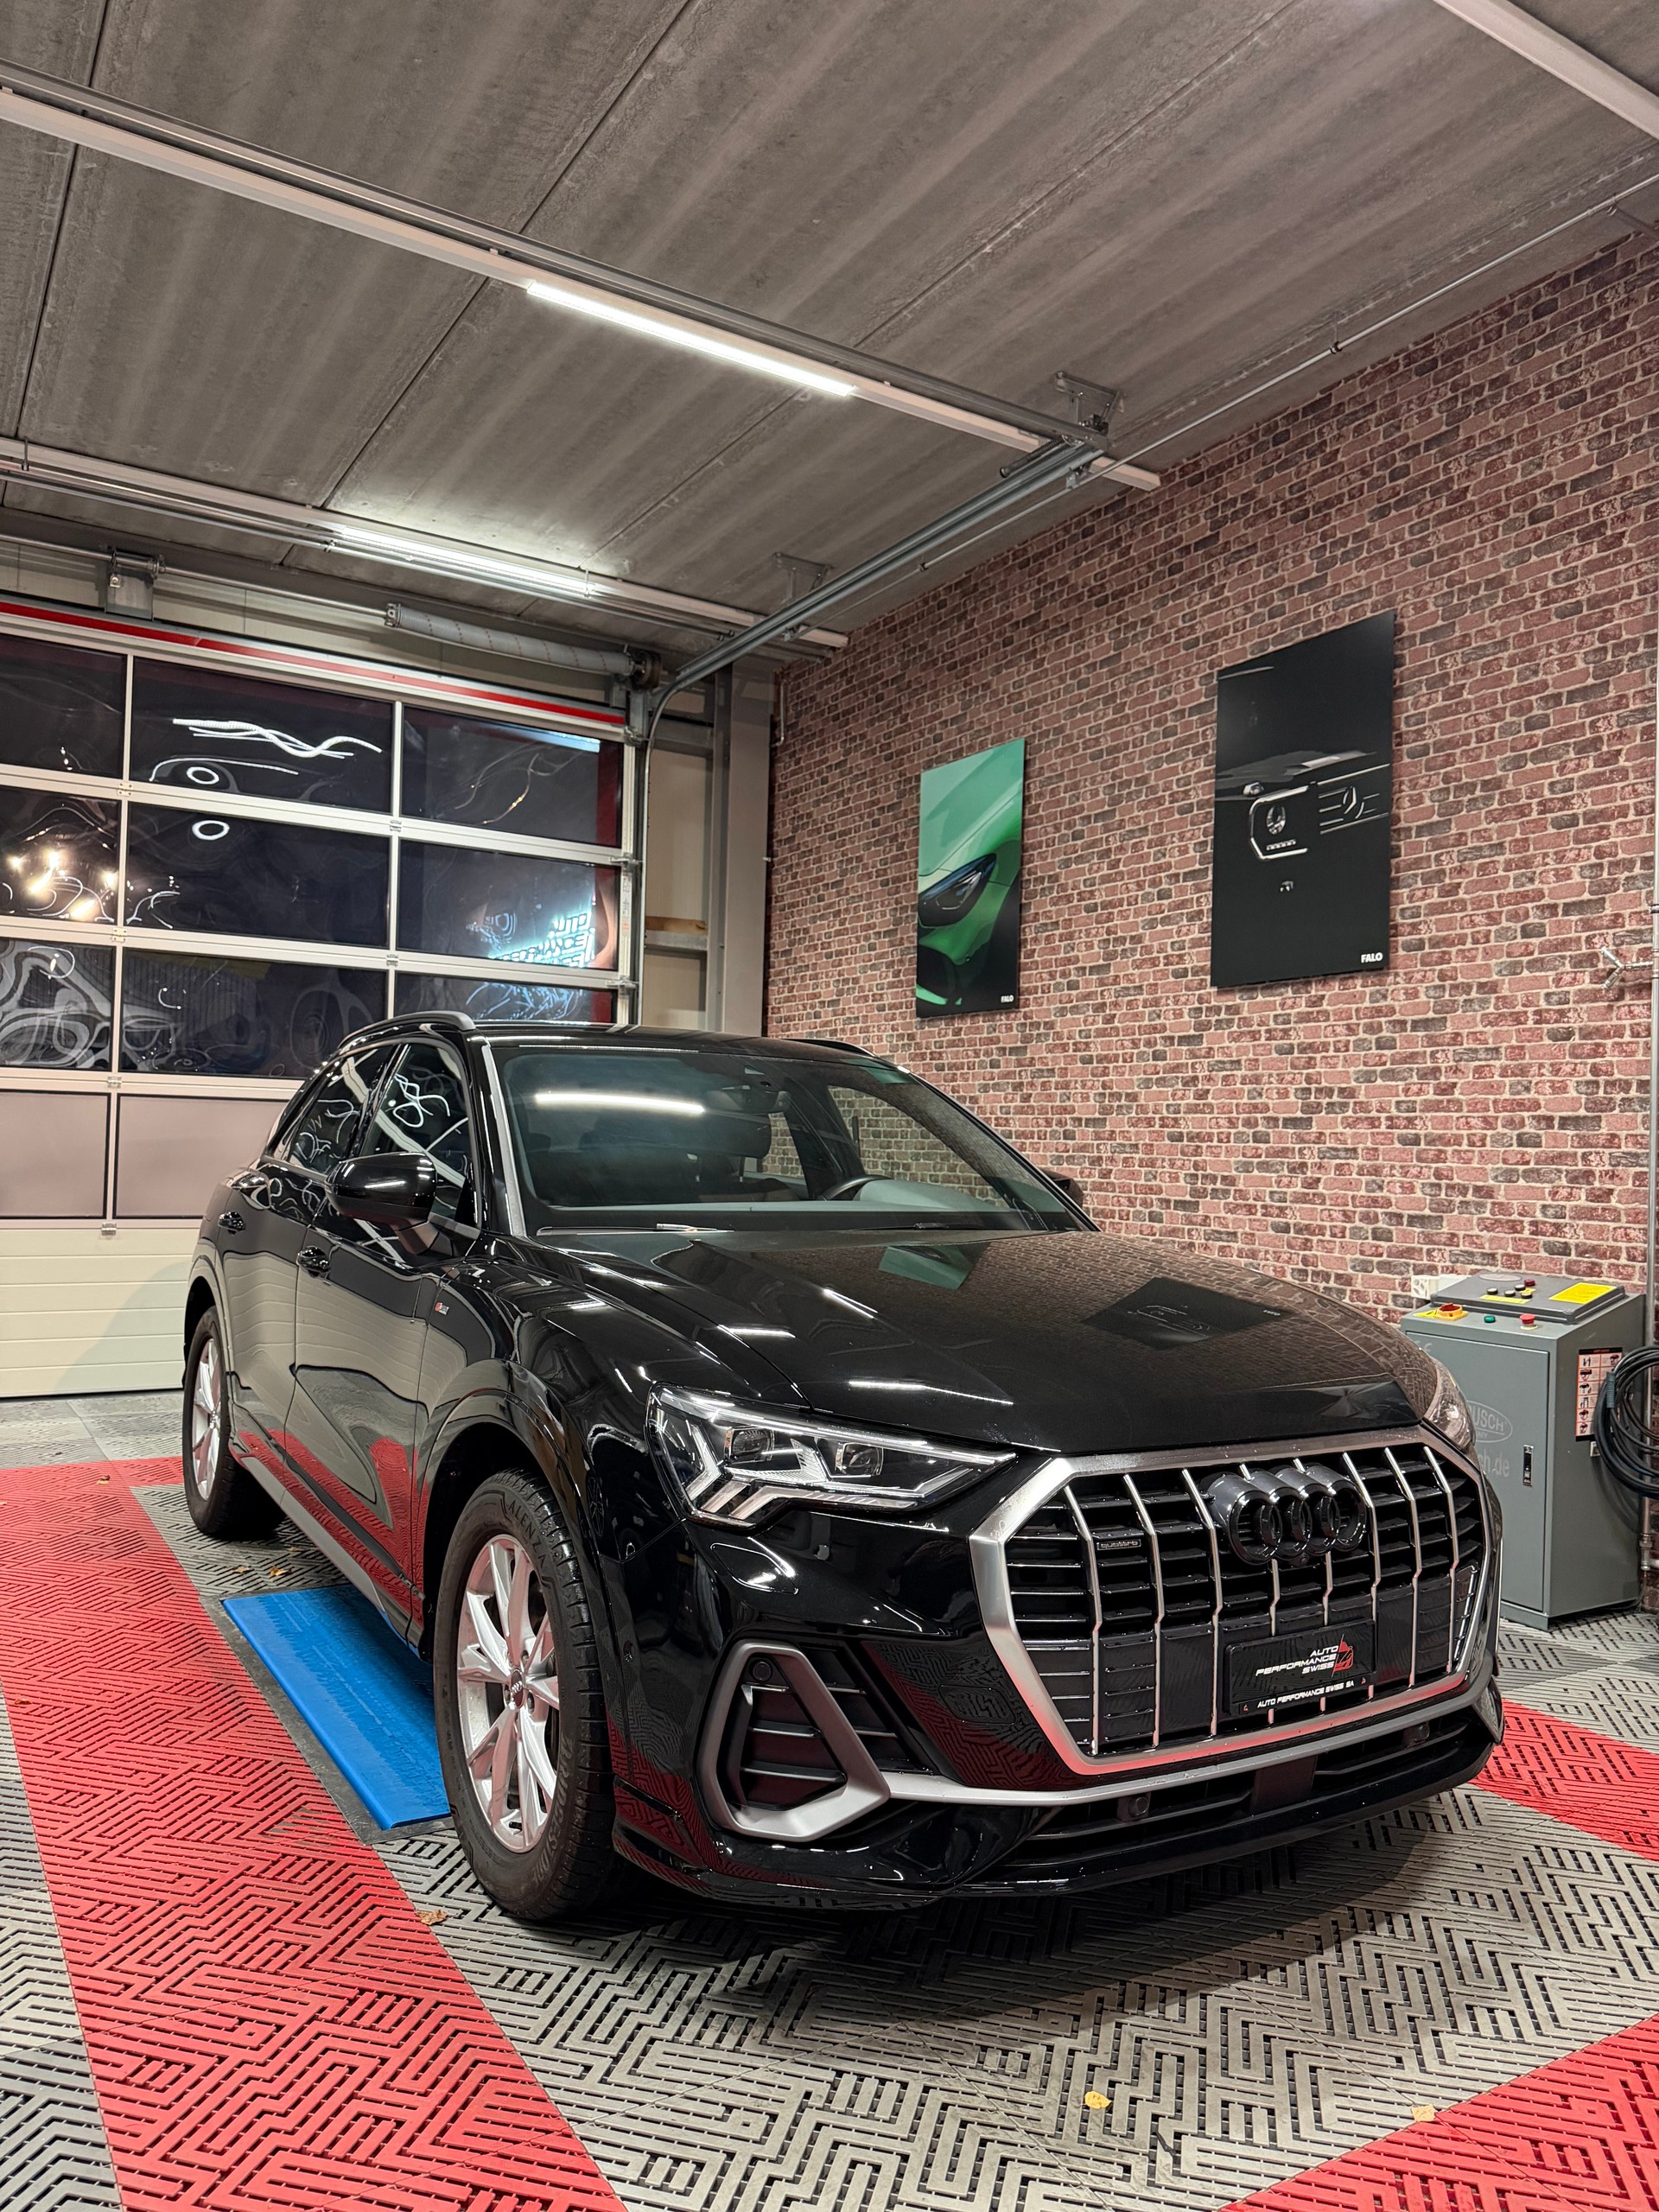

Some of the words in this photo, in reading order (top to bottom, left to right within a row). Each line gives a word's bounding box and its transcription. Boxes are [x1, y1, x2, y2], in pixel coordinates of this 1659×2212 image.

[1360, 951, 1383, 963] FALO
[1468, 1404, 1503, 1432] USCH
[1100, 1541, 1139, 1549] quattro
[1311, 1645, 1338, 1657] AUTO
[1255, 1653, 1337, 1676] PERFORMANCE
[1302, 1662, 1334, 1674] SWISS
[1257, 1698, 1275, 1708] AUTO
[1277, 1687, 1325, 1703] PERFORMANCE
[1325, 1683, 1344, 1694] SWISS
